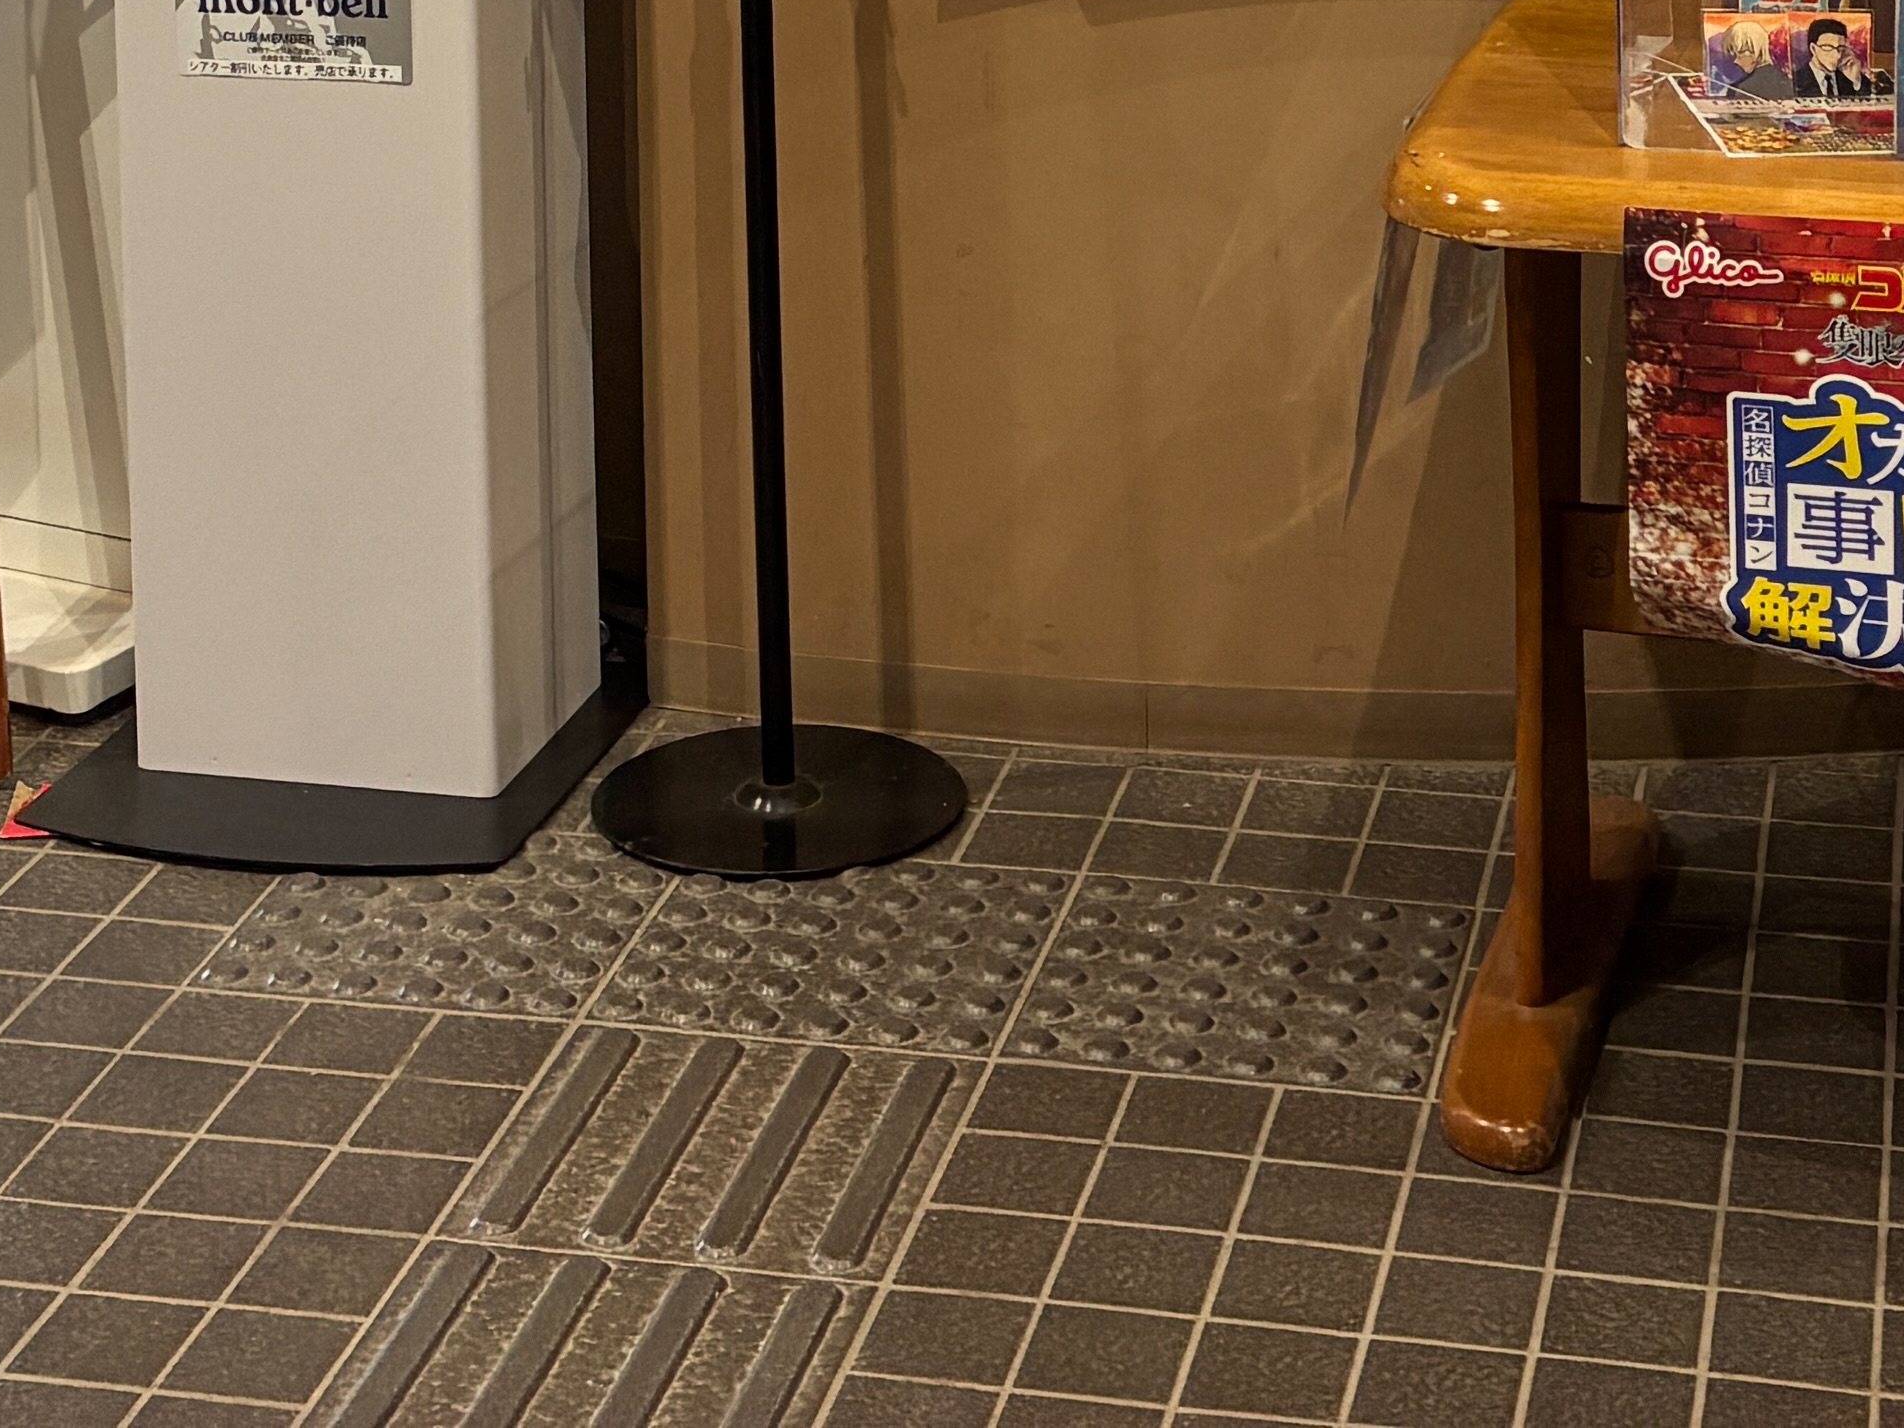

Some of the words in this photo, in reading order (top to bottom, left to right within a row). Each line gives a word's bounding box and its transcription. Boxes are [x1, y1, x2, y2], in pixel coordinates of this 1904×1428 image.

[223, 32, 257, 43] CLUB
[260, 33, 315, 45] MEMBER
[1742, 405, 1776, 569] 名探偵コナン
